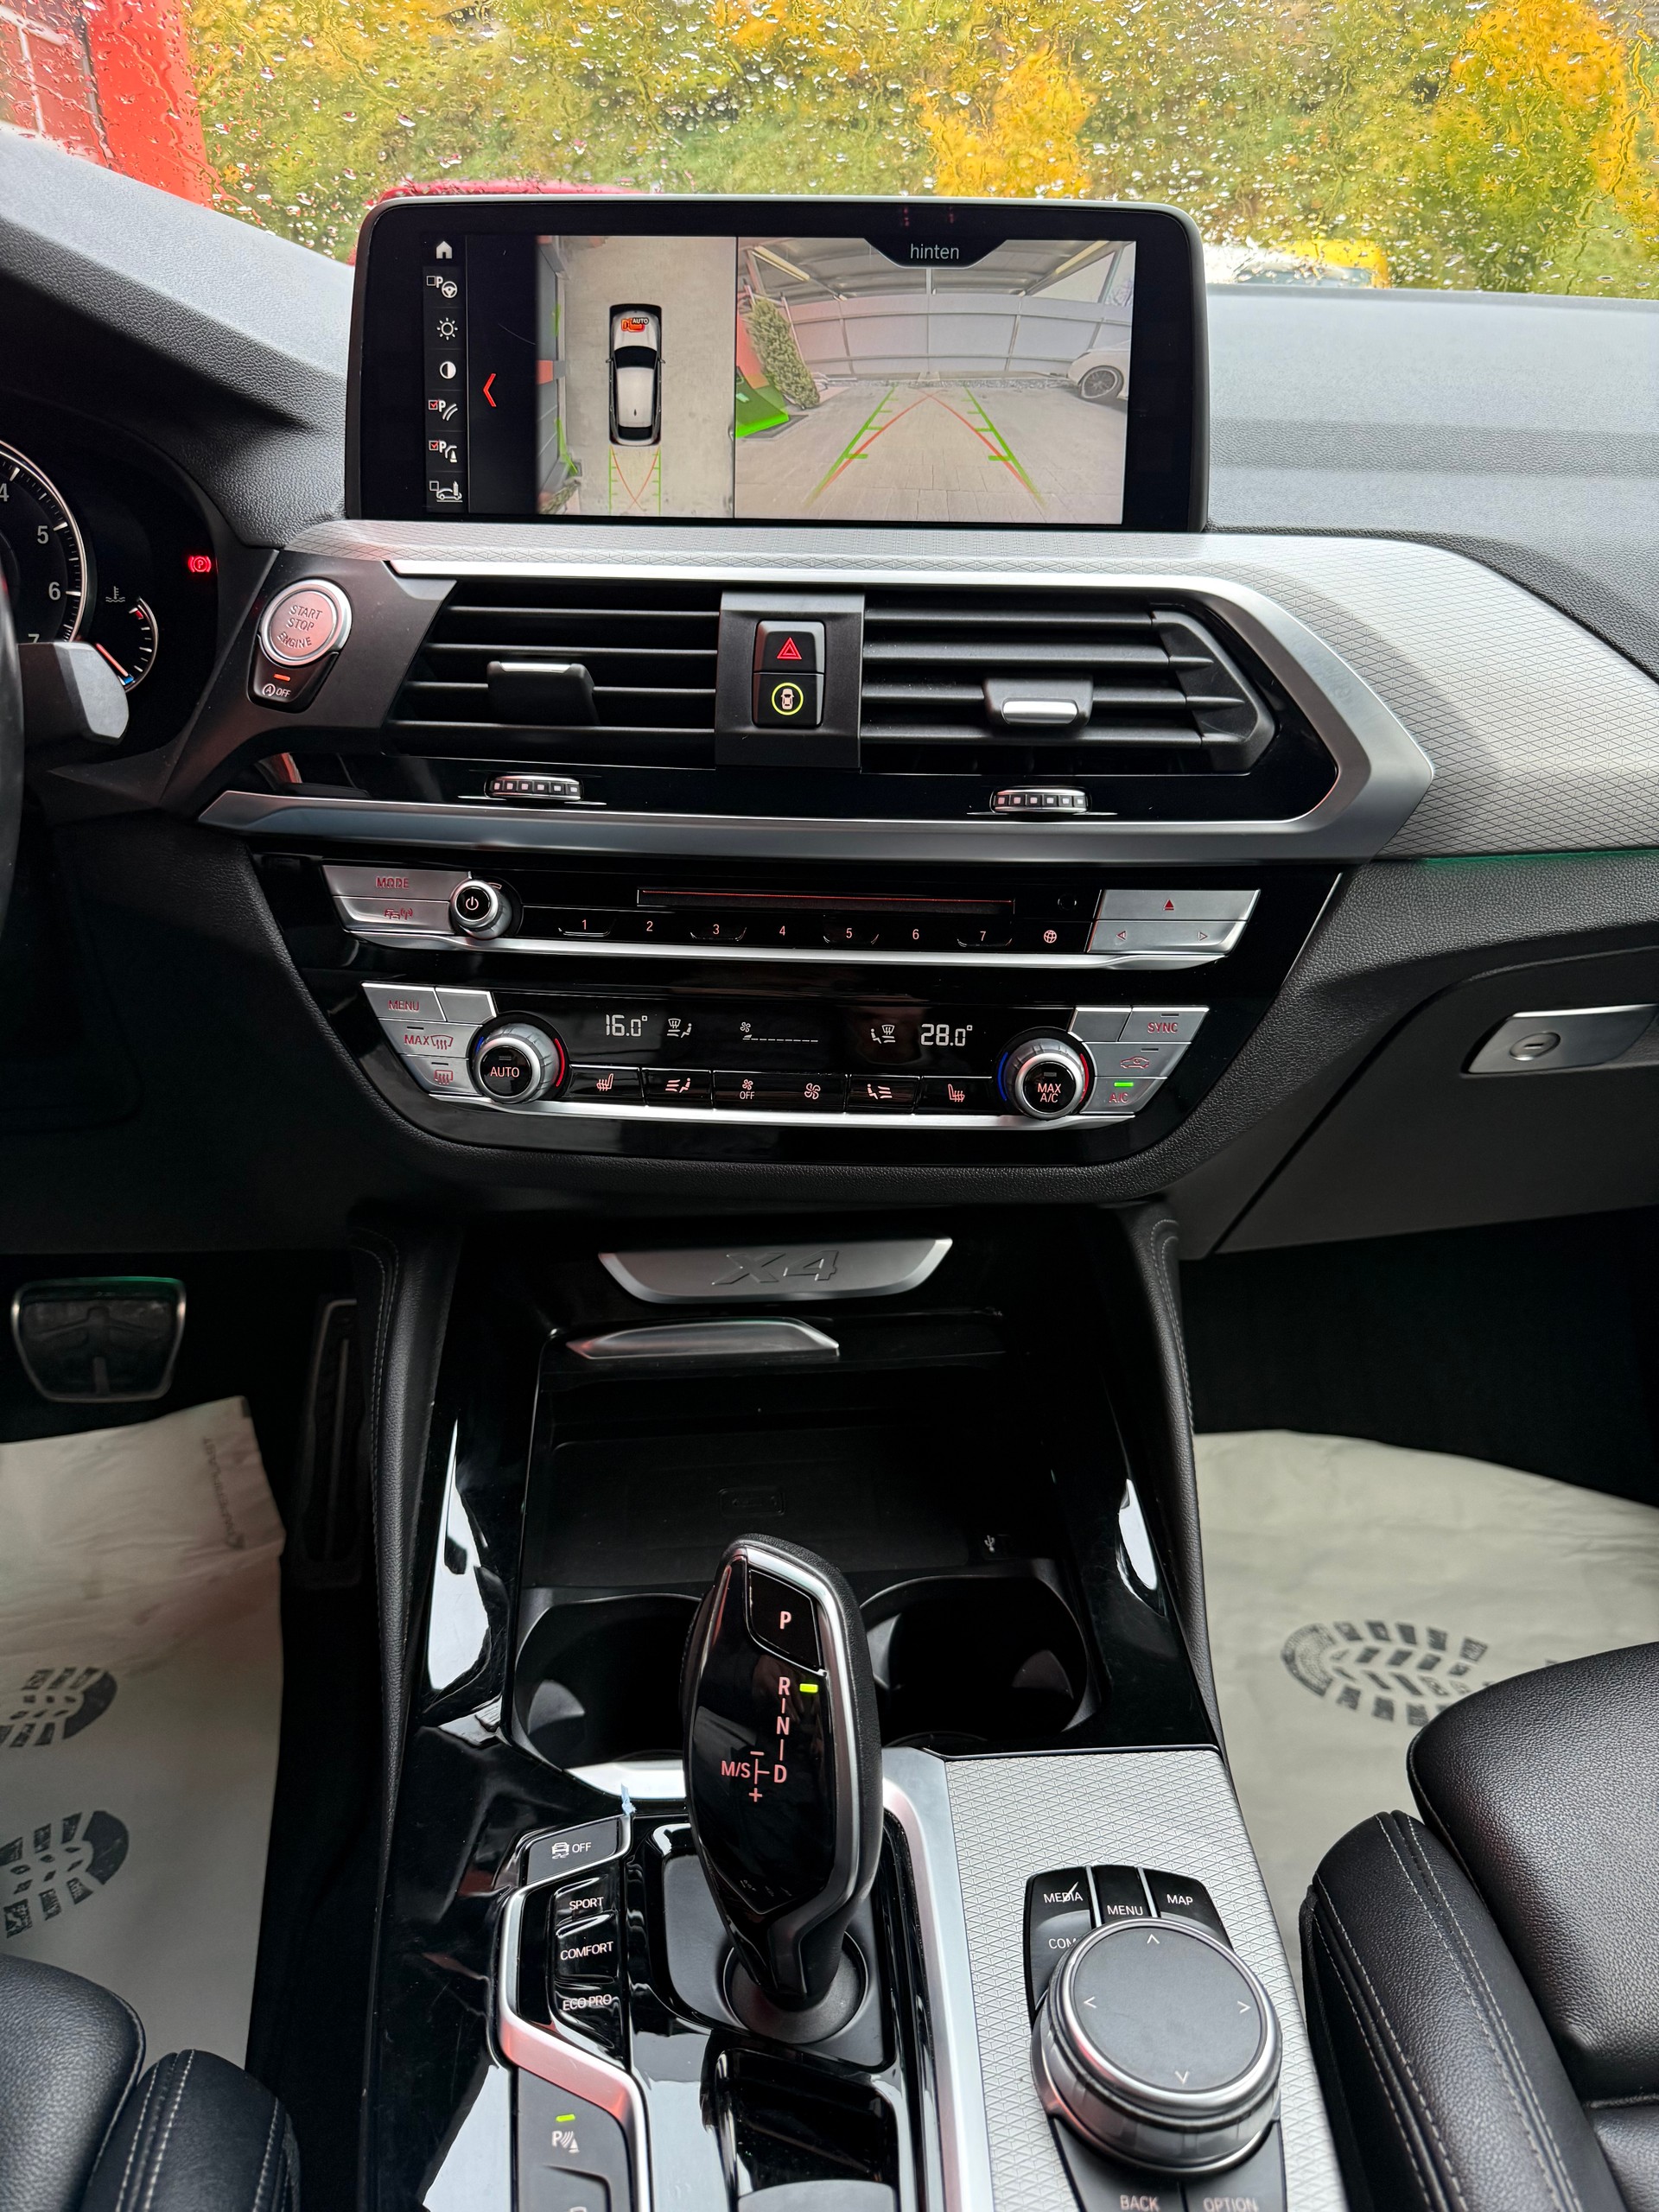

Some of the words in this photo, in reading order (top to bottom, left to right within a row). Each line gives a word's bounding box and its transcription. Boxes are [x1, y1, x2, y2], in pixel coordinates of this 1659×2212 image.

[910, 244, 960, 260] hinten
[0, 483, 10, 502] 4
[37, 525, 49, 544] 5
[48, 582, 60, 600] 6
[290, 605, 323, 620] START
[287, 617, 315, 632] STOP
[276, 632, 313, 649] ENGINE
[276, 688, 291, 697] OFF
[376, 876, 410, 890] MODE
[582, 919, 588, 931] 1
[646, 921, 653, 932] 2
[713, 924, 720, 935] 3
[779, 925, 786, 937] 4
[846, 928, 853, 938] 5
[912, 929, 919, 940] 6
[979, 931, 987, 942] 7
[388, 1000, 420, 1012] MENU
[1147, 1021, 1178, 1034] SYNC
[404, 1034, 430, 1046] MAX
[490, 1065, 520, 1079] AUTO
[739, 1090, 755, 1100] OFF
[1037, 1083, 1062, 1094] MAX
[1039, 1092, 1058, 1103] A/C
[1109, 1091, 1128, 1103] A/C
[710, 1249, 840, 1286] X4
[779, 1611, 791, 1630] P
[779, 1676, 791, 1696] R
[776, 1716, 790, 1735] N
[721, 1760, 751, 1778] M/S
[773, 1763, 787, 1783] D
[571, 1841, 592, 1854] OFF
[569, 1897, 604, 1910] SPORT
[1043, 1891, 1084, 1904] MEDIA
[1166, 1893, 1193, 1906] MAP
[1107, 1904, 1143, 1916] MENU
[560, 1942, 613, 1961] COMFORT
[563, 1998, 586, 2011] ECO
[588, 1993, 613, 2007] PRO
[551, 2130, 563, 2146] P
[1120, 2195, 1160, 2211] BACK
[1203, 2197, 1259, 2212] OPTION
